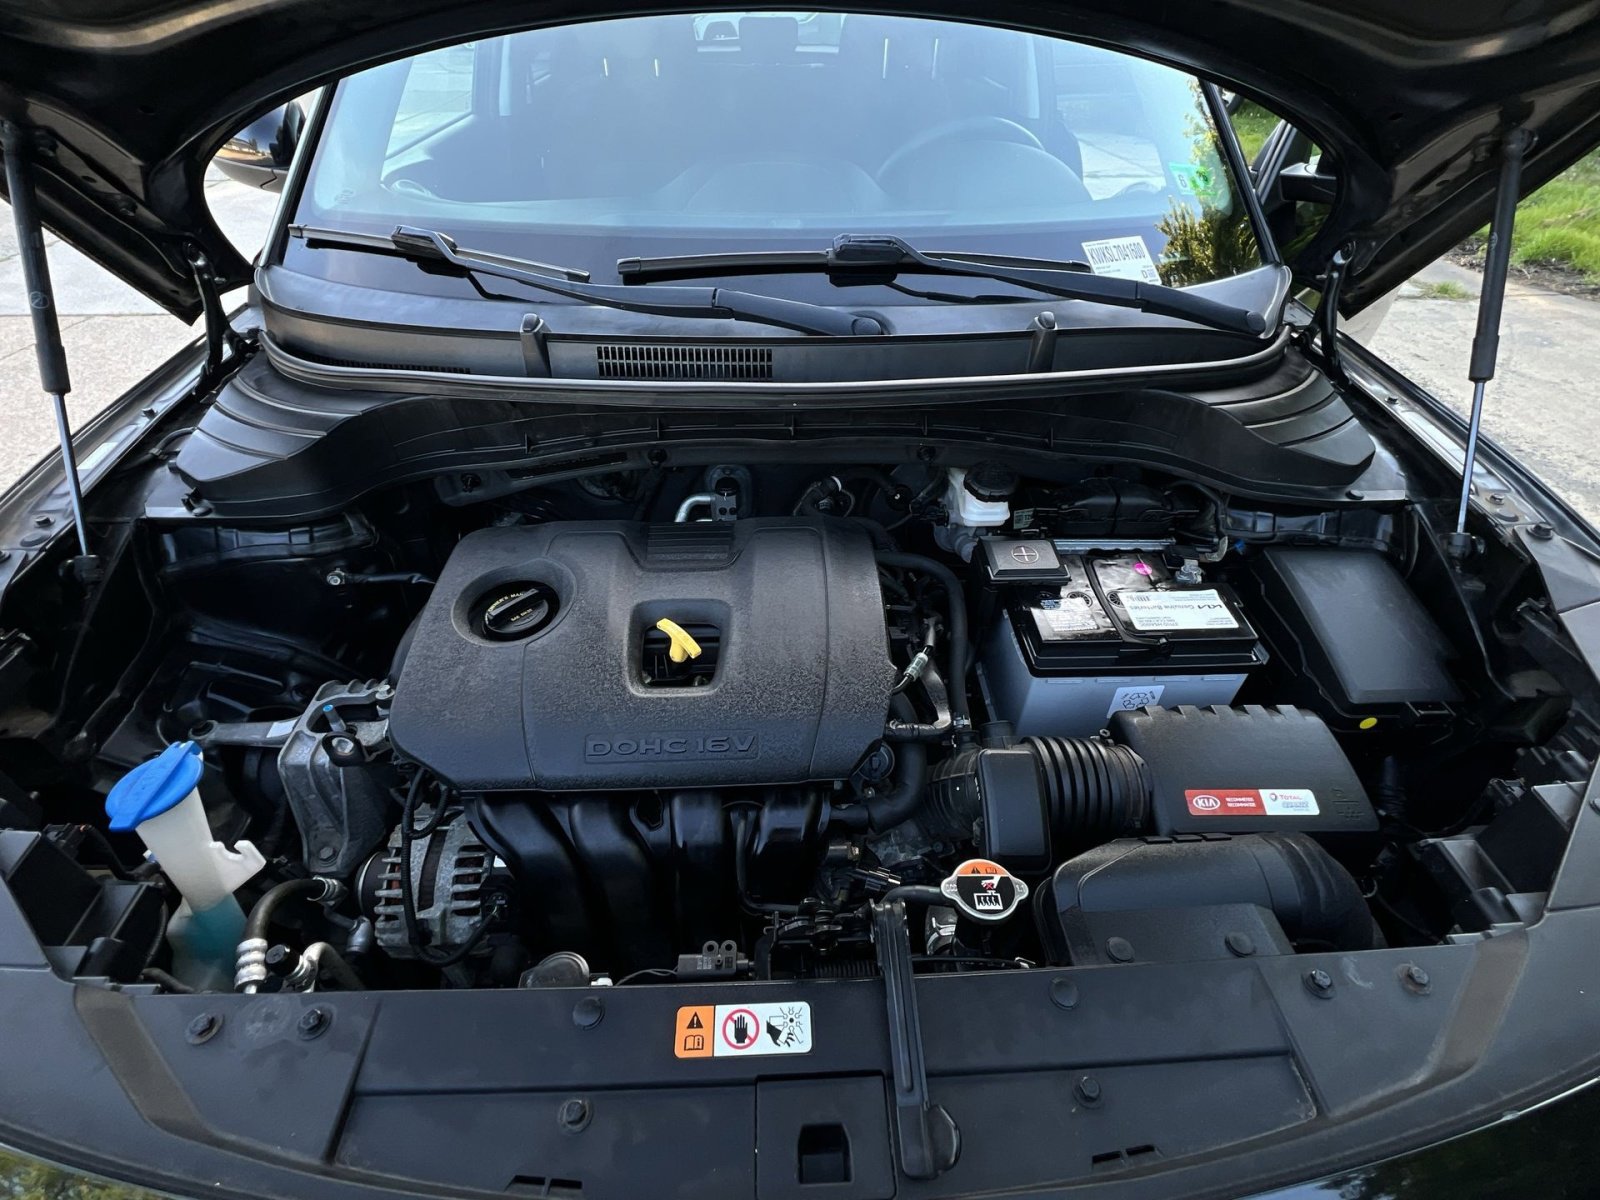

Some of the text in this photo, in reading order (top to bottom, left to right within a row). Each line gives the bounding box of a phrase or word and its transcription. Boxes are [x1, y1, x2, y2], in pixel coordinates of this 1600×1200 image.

[587, 735, 756, 756] DOHC 16V
[1197, 797, 1217, 808] KIA
